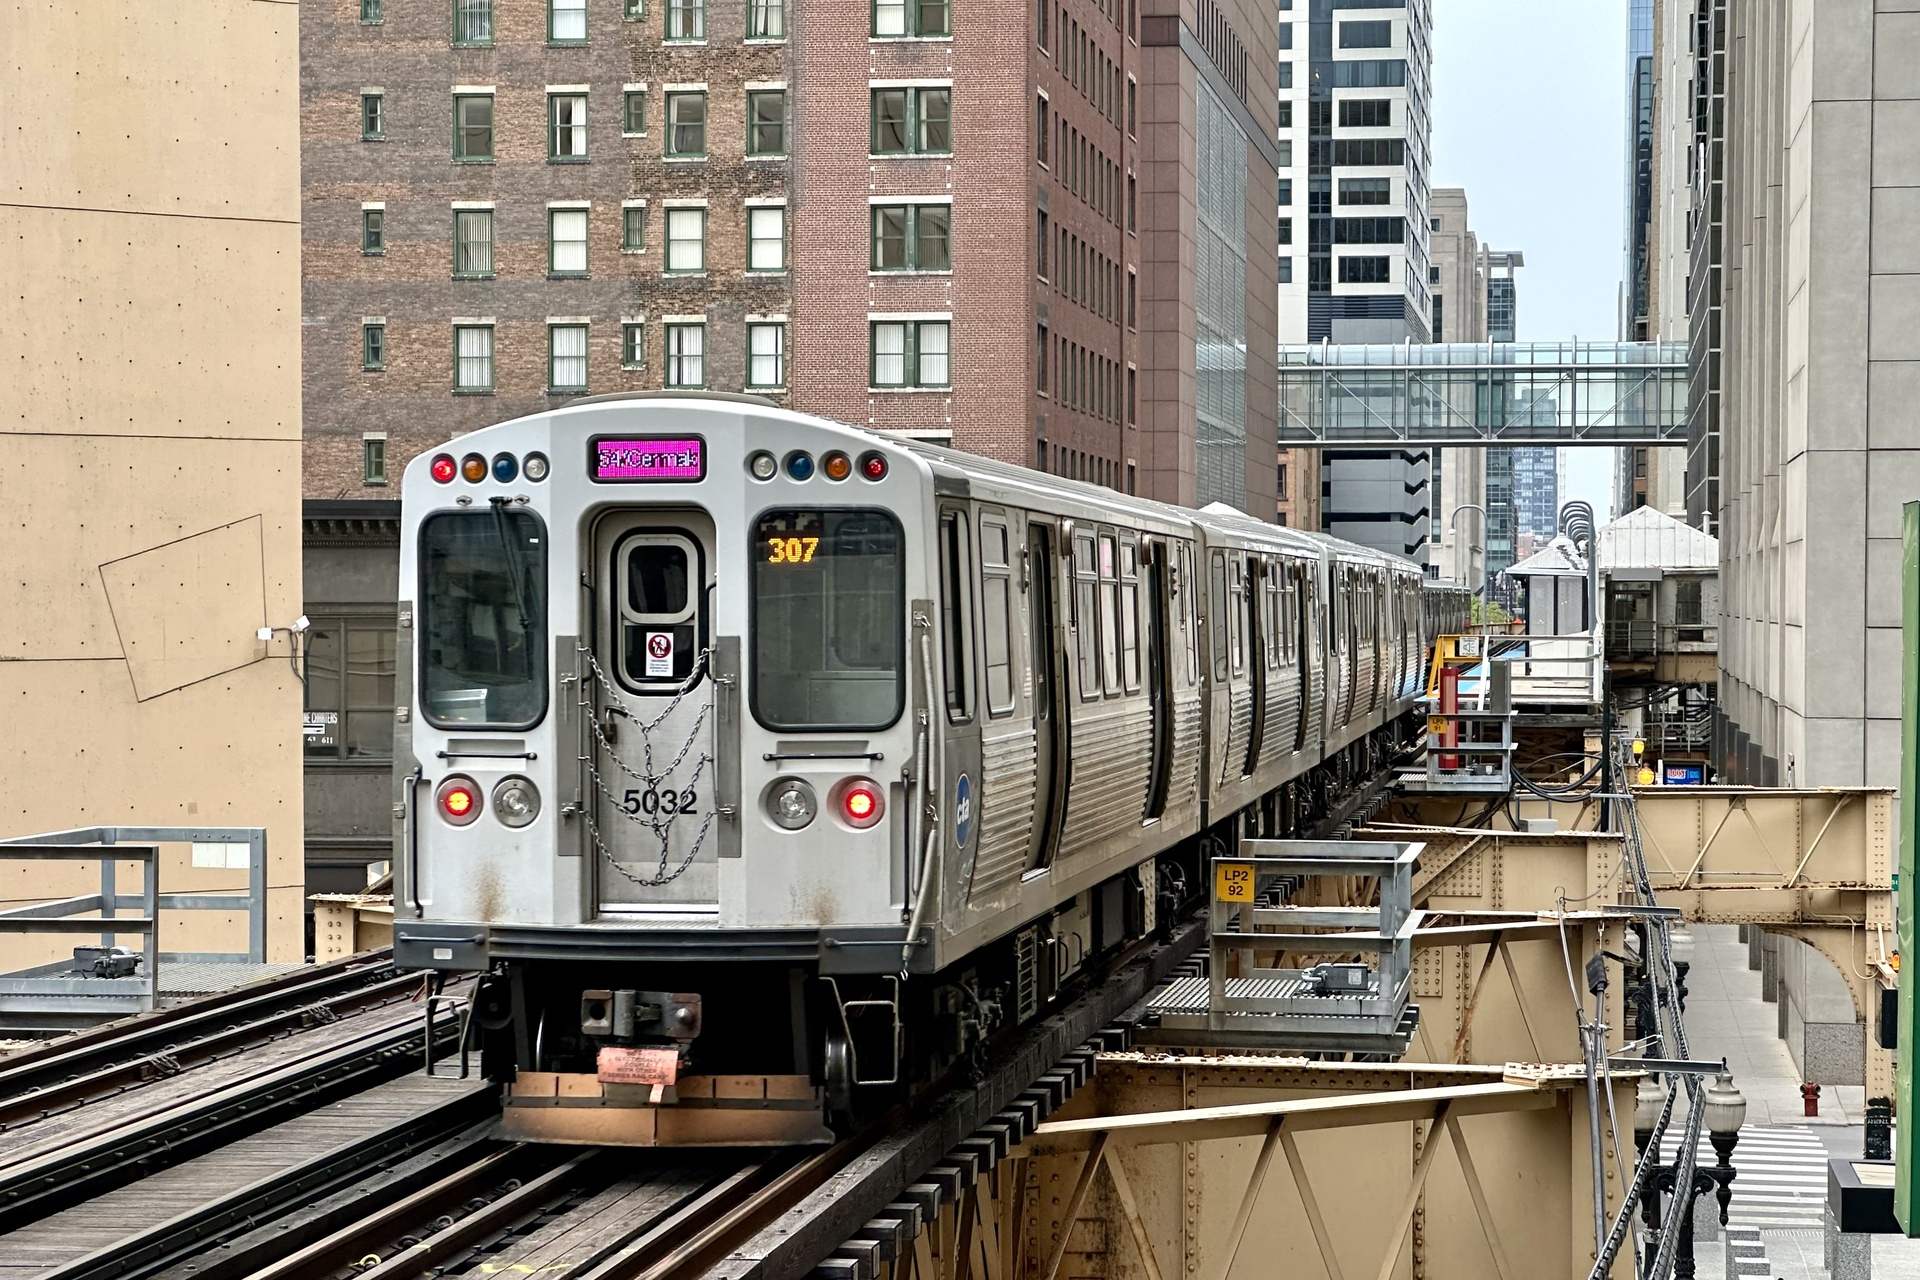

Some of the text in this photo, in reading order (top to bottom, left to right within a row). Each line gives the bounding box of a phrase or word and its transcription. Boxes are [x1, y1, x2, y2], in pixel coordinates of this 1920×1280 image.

[768, 537, 819, 563] 307
[1667, 769, 1686, 777] BOOST
[624, 789, 697, 815] 5032
[957, 796, 970, 826] cta
[1224, 870, 1249, 881] LP2
[1228, 885, 1244, 896] 92
